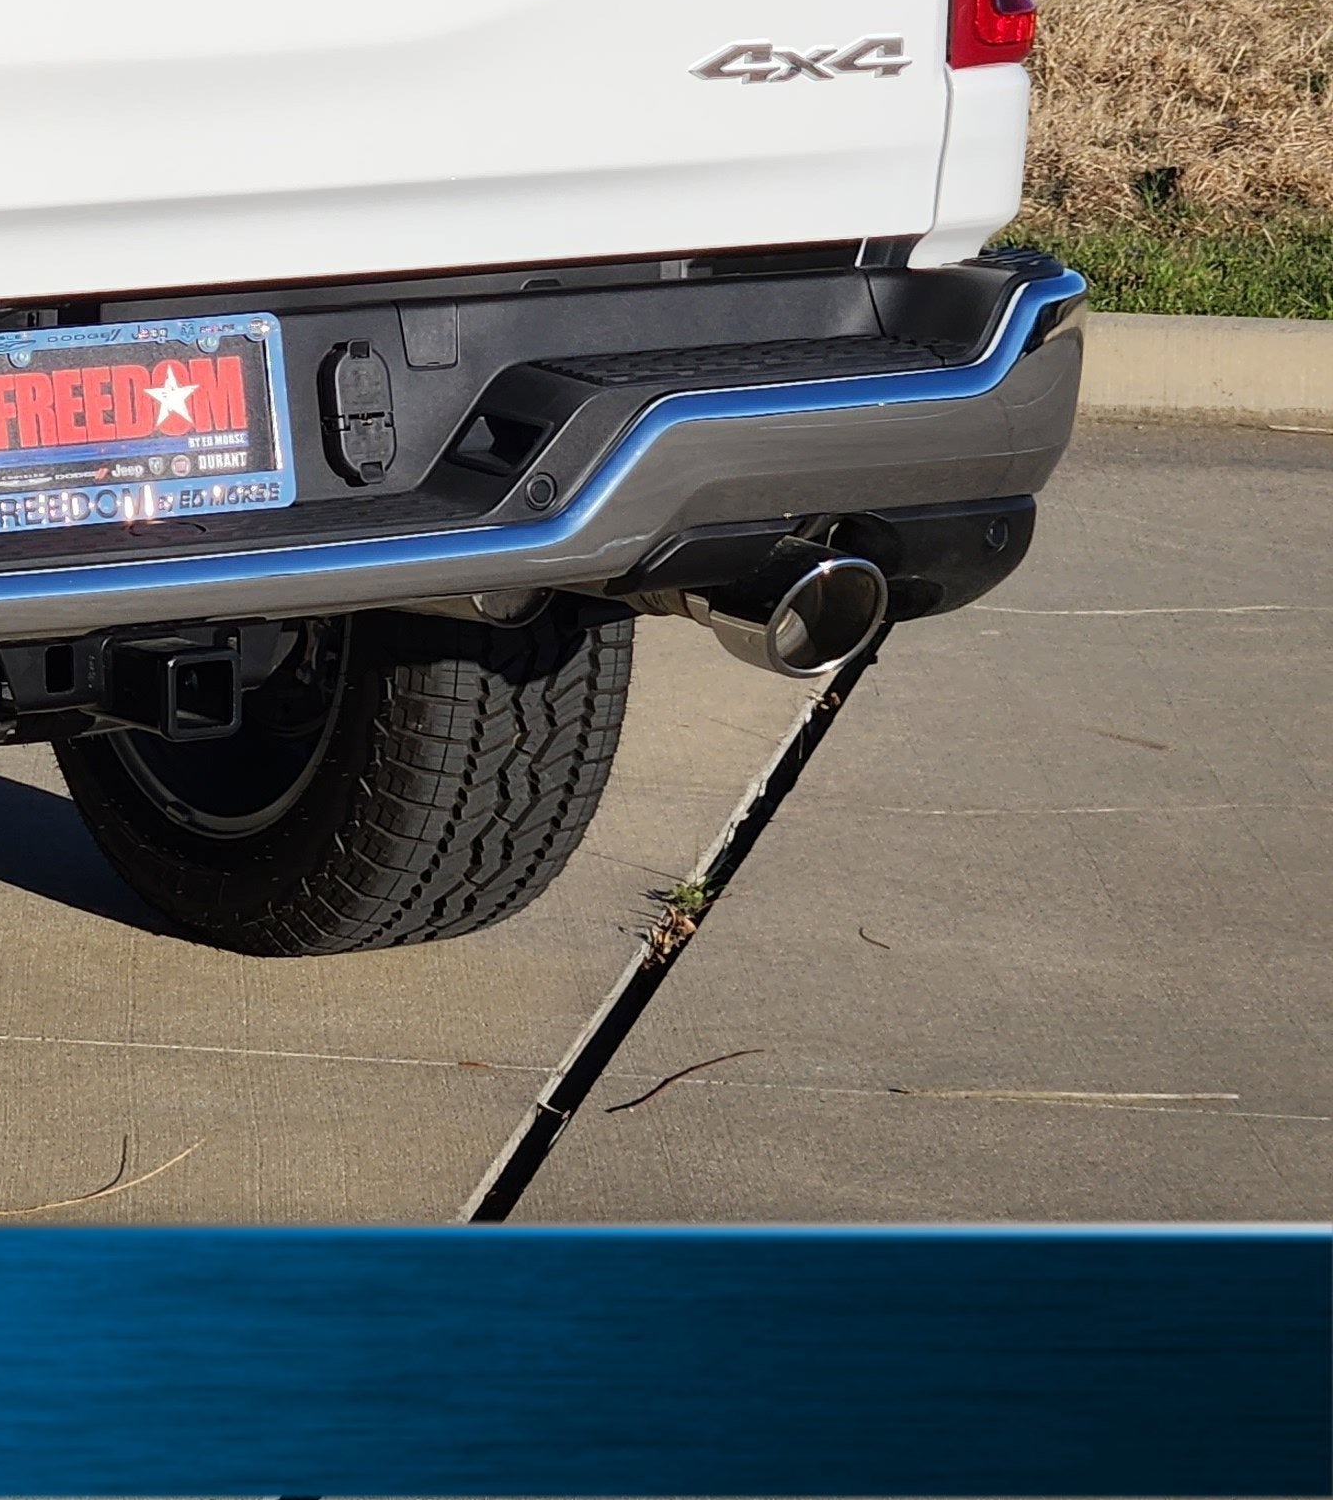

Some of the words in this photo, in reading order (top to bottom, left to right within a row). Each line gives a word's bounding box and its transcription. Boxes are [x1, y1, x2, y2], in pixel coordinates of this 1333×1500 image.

[688, 34, 914, 85] 4x4
[47, 331, 110, 343] DODGE
[131, 325, 169, 342] Jeep
[188, 437, 200, 448] BY
[202, 435, 214, 447] ED
[215, 432, 245, 445] MORSE
[198, 451, 247, 470] DURANT
[54, 470, 97, 480] DODGE
[111, 463, 144, 478] Jeep
[179, 489, 205, 510] ED
[210, 482, 280, 507] MORSE
